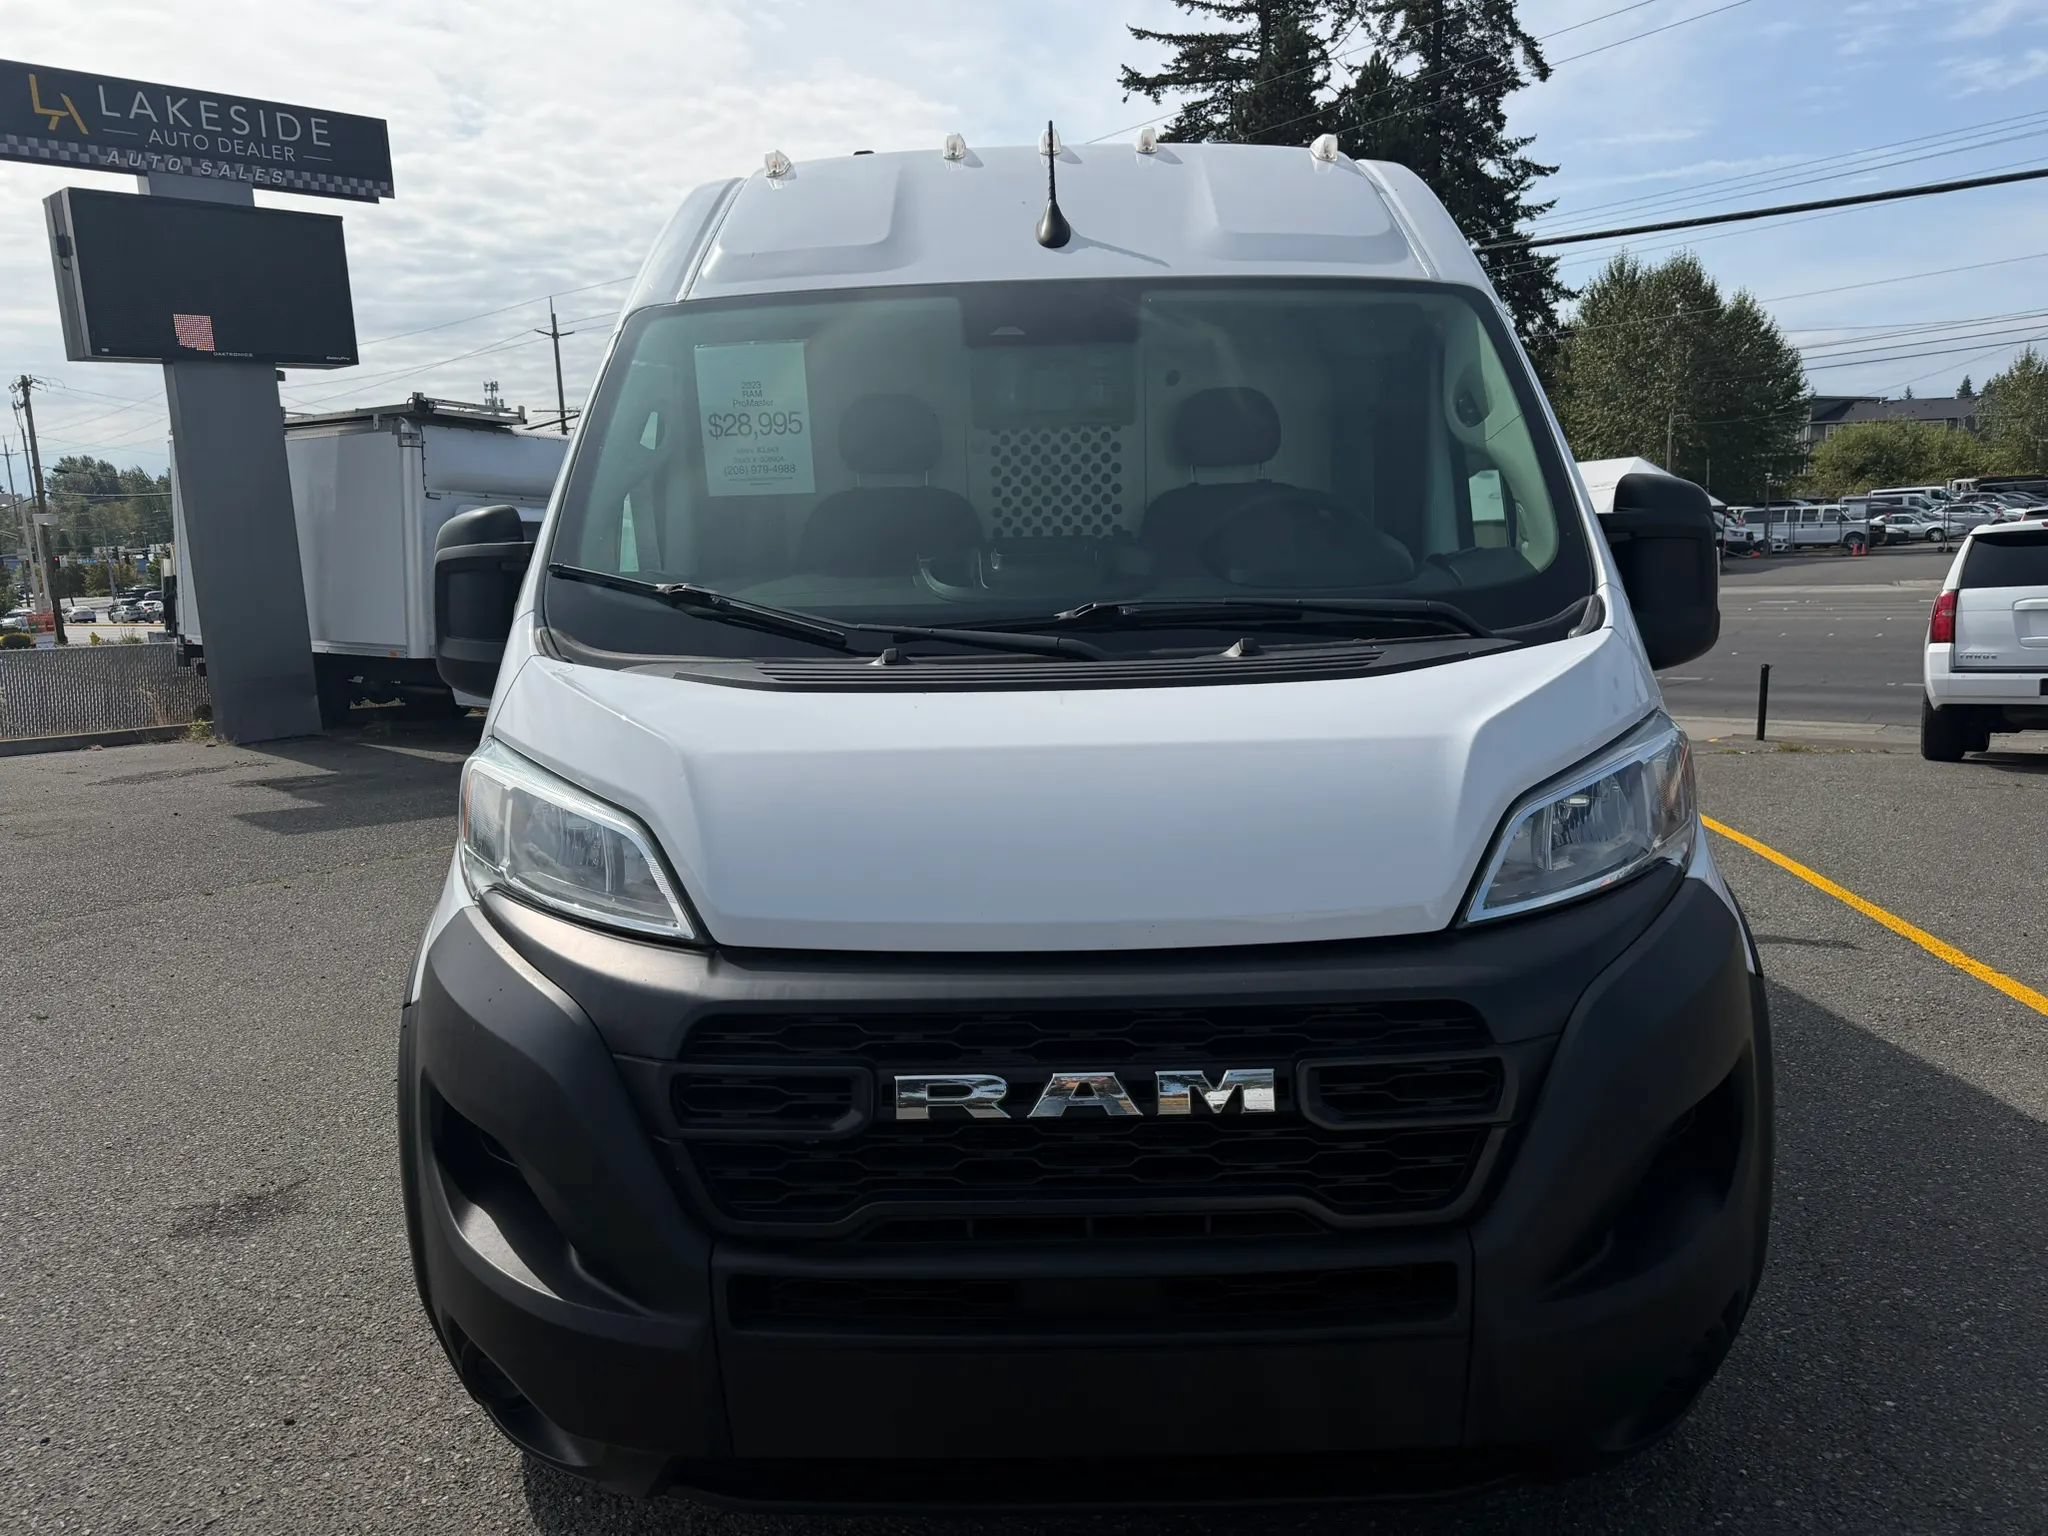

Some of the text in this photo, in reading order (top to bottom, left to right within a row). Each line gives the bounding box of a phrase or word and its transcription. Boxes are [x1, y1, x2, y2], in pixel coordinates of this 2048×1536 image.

[98, 85, 331, 147] LAKESIDE
[149, 128, 296, 162] AUTO DEALER
[107, 151, 284, 184] AUTO SALES
[742, 390, 762, 398] RAM
[708, 411, 803, 440] $28,995
[894, 1068, 1276, 1120] RAM
